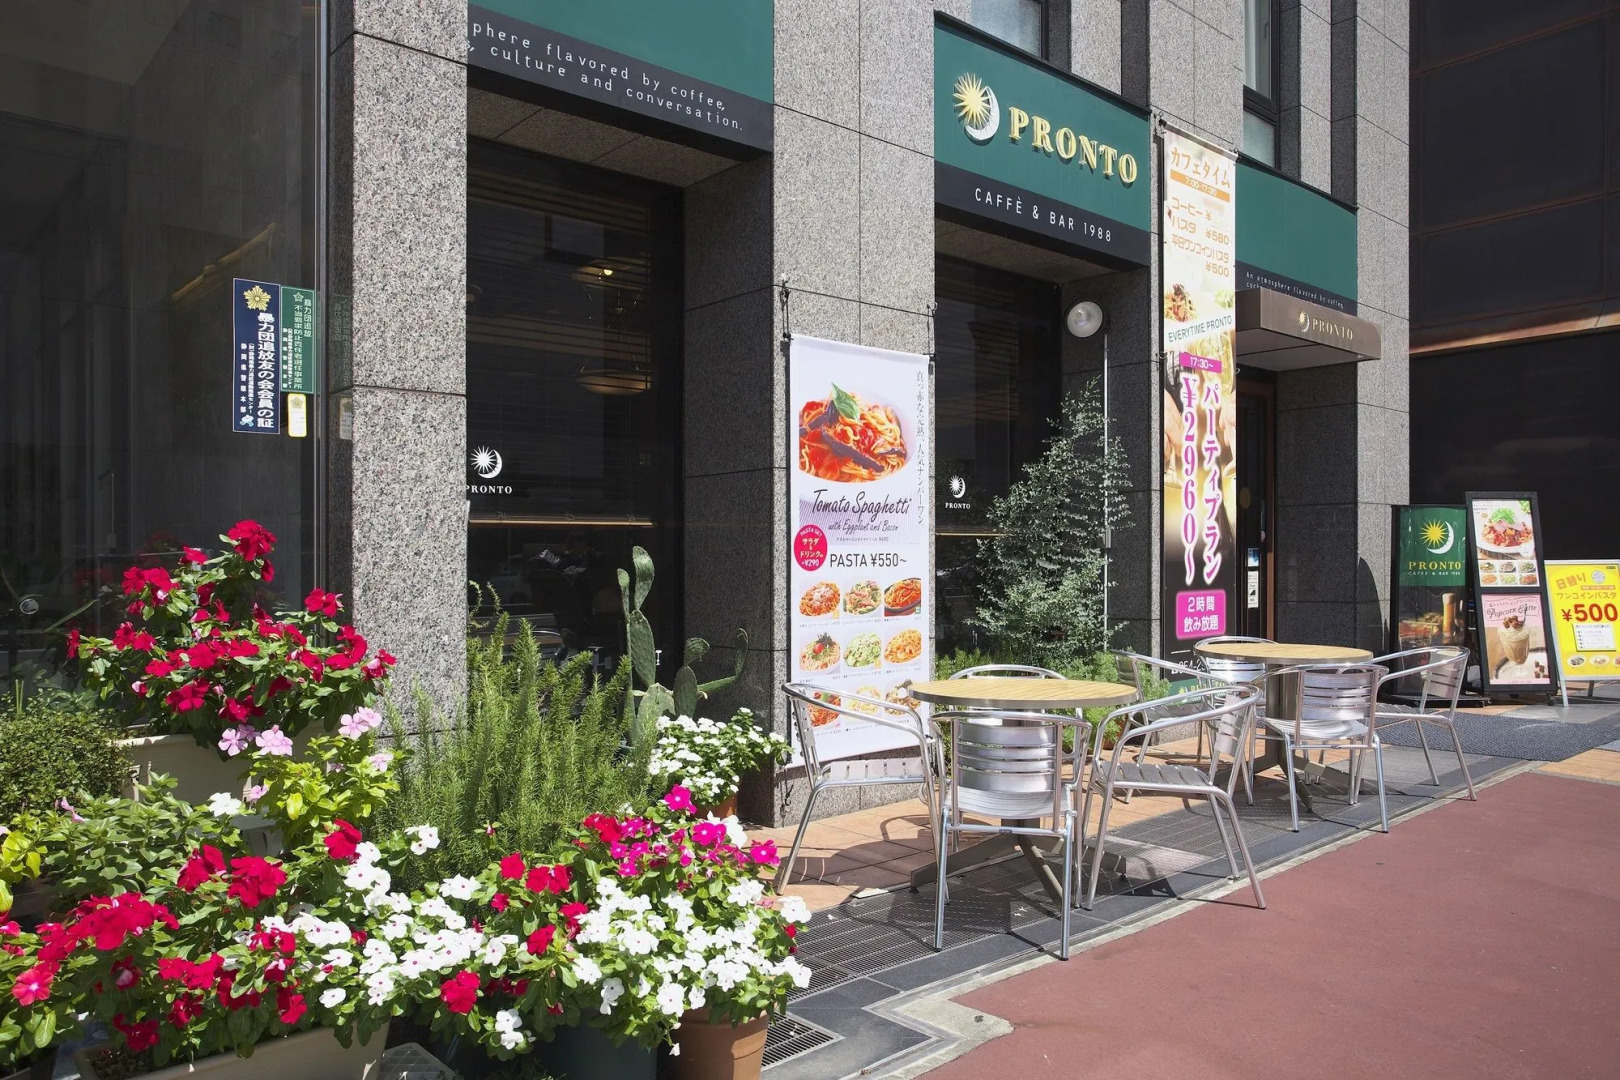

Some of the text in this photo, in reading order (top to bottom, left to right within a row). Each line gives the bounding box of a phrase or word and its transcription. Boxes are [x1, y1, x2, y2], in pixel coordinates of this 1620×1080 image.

[473, 22, 726, 111] phere flavored by coffee,
[490, 44, 566, 77] culture
[580, 73, 613, 92] and
[626, 87, 744, 131] conversation.
[1008, 106, 1138, 184] PRONTO
[1170, 147, 1231, 189] カフェタイム
[974, 187, 1112, 242] CAFFÈ & BAR 1988
[1171, 196, 1203, 216] コーヒー
[1205, 260, 1230, 278] ¥500
[1246, 271, 1254, 279] An
[1256, 275, 1290, 291] atmosphere
[1293, 285, 1317, 300] flavored
[1320, 294, 1326, 304] by
[303, 298, 312, 338] 暴力団追放
[1168, 314, 1233, 343] EVERYTIME PRONTO
[1312, 318, 1354, 340] PRONTO
[240, 342, 248, 413] 静岡県警察本部
[257, 312, 275, 428] 暴力団追放友の会会員の証
[1203, 383, 1220, 580] パーティプラン
[812, 488, 912, 522] Tomato Spaghetti
[945, 502, 971, 510] PRONTO
[828, 518, 899, 535] with Eggplant and Bacon
[802, 537, 819, 546] サラダ
[830, 553, 868, 568] PASTA
[1408, 560, 1462, 571] PRONTO
[1556, 572, 1587, 590] 日替り
[1187, 596, 1215, 613] 2時間
[1557, 591, 1617, 600] ワンコインパスタ
[1485, 606, 1517, 619] Popcorn
[1561, 603, 1618, 622] ¥500
[1183, 614, 1219, 633] 飲み放題
